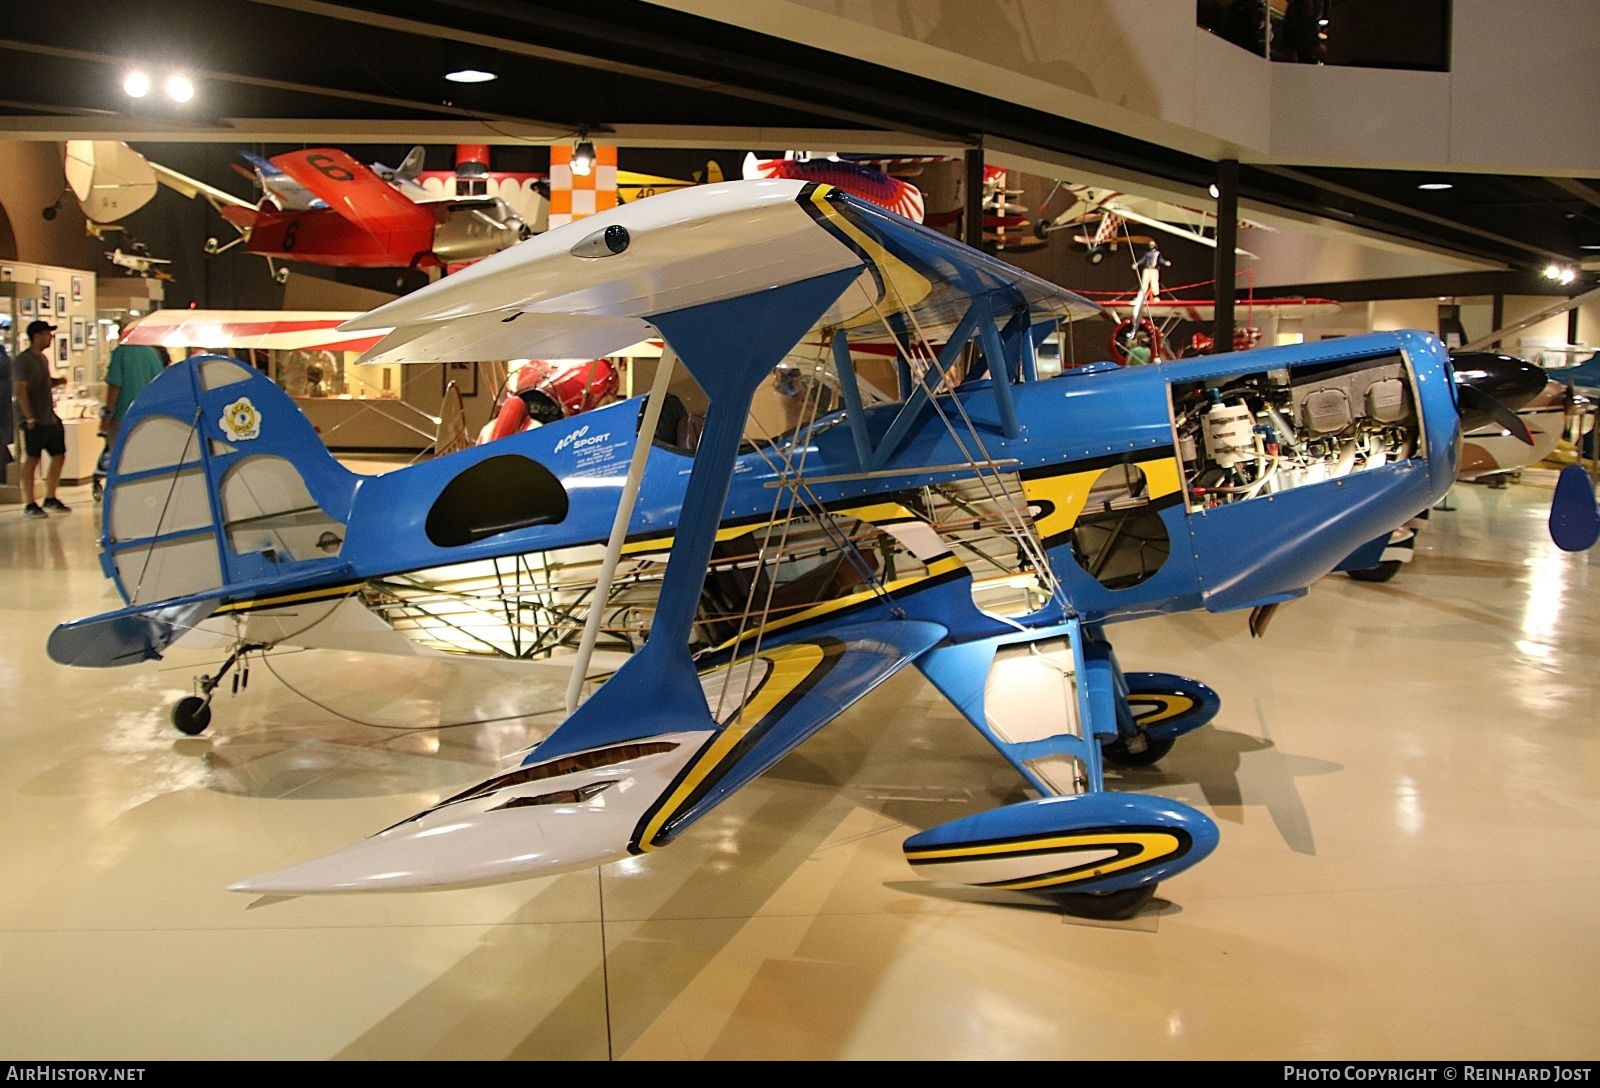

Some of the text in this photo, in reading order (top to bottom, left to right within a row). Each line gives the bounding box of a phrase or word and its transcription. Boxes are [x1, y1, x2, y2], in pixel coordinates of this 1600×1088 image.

[306, 154, 354, 181] 6
[283, 220, 301, 252] 6
[554, 425, 590, 454] ACRO
[573, 432, 611, 449] SPORT
